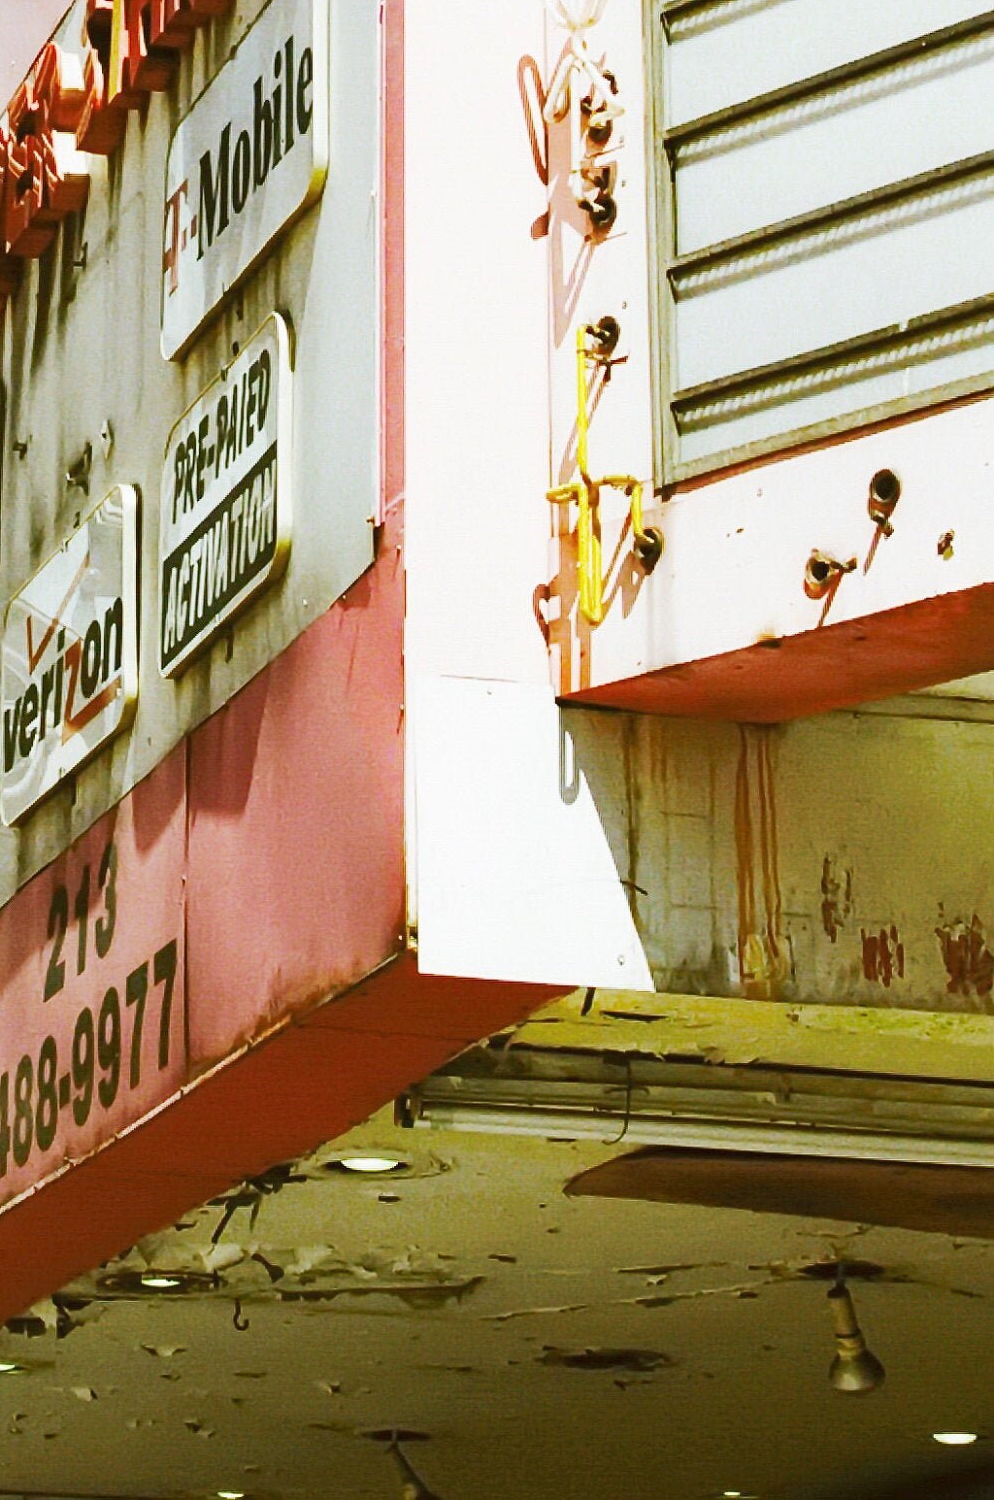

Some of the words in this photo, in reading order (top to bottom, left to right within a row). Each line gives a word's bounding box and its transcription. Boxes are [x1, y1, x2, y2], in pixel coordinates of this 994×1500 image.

[164, 459, 277, 654] ACTIVATION
[4, 596, 123, 774] verizon
[44, 840, 118, 1003] 213
